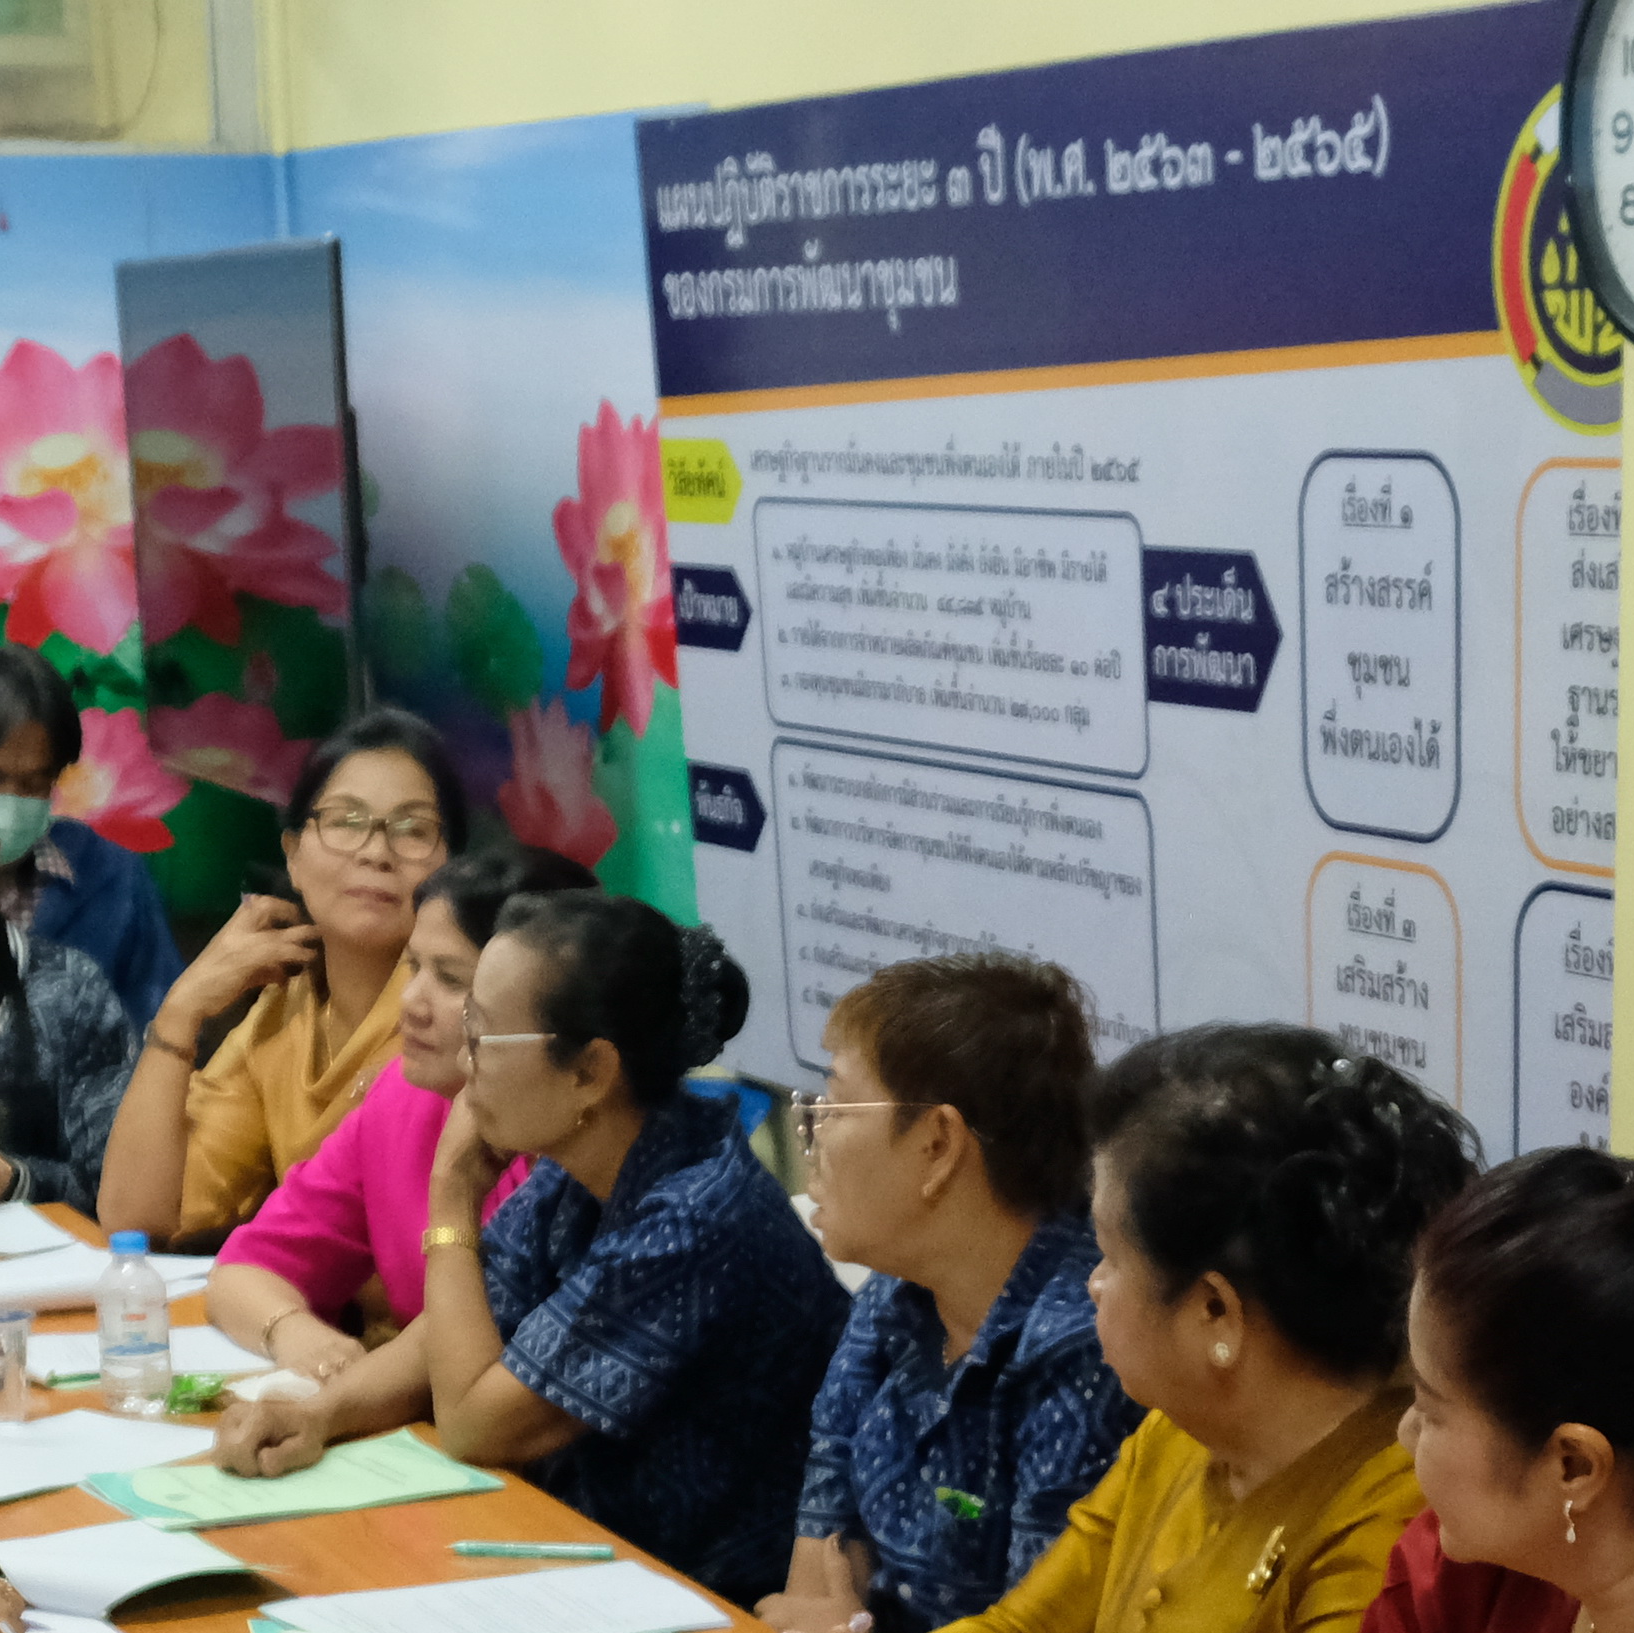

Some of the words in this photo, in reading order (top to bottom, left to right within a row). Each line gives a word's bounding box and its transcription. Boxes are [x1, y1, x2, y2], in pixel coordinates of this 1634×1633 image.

[1612, 110, 1634, 154] 9
[657, 151, 939, 249] แผนปฏิบัติราชการระยะ
[946, 165, 972, 208] ๓
[976, 122, 1006, 206] ปี
[1015, 132, 1096, 208] (พ.ศ.
[1104, 131, 1215, 195] ๒๕๖๓
[1252, 93, 1389, 181] ๒๕๖๕)
[663, 238, 958, 333] ของกรมการพัฒนาชุมชน
[1341, 474, 1393, 526] เรื่องที่
[1175, 565, 1256, 625] ประเด็น
[1324, 555, 1433, 611] สร้างสรรค์
[1152, 631, 1257, 688] การพัฒนา
[1347, 649, 1410, 700] ชุมชน
[1320, 697, 1441, 769] พึ่งตนเองได้
[1346, 882, 1396, 934] เรื่องที่
[1335, 953, 1429, 1010] เสริมสร้าง
